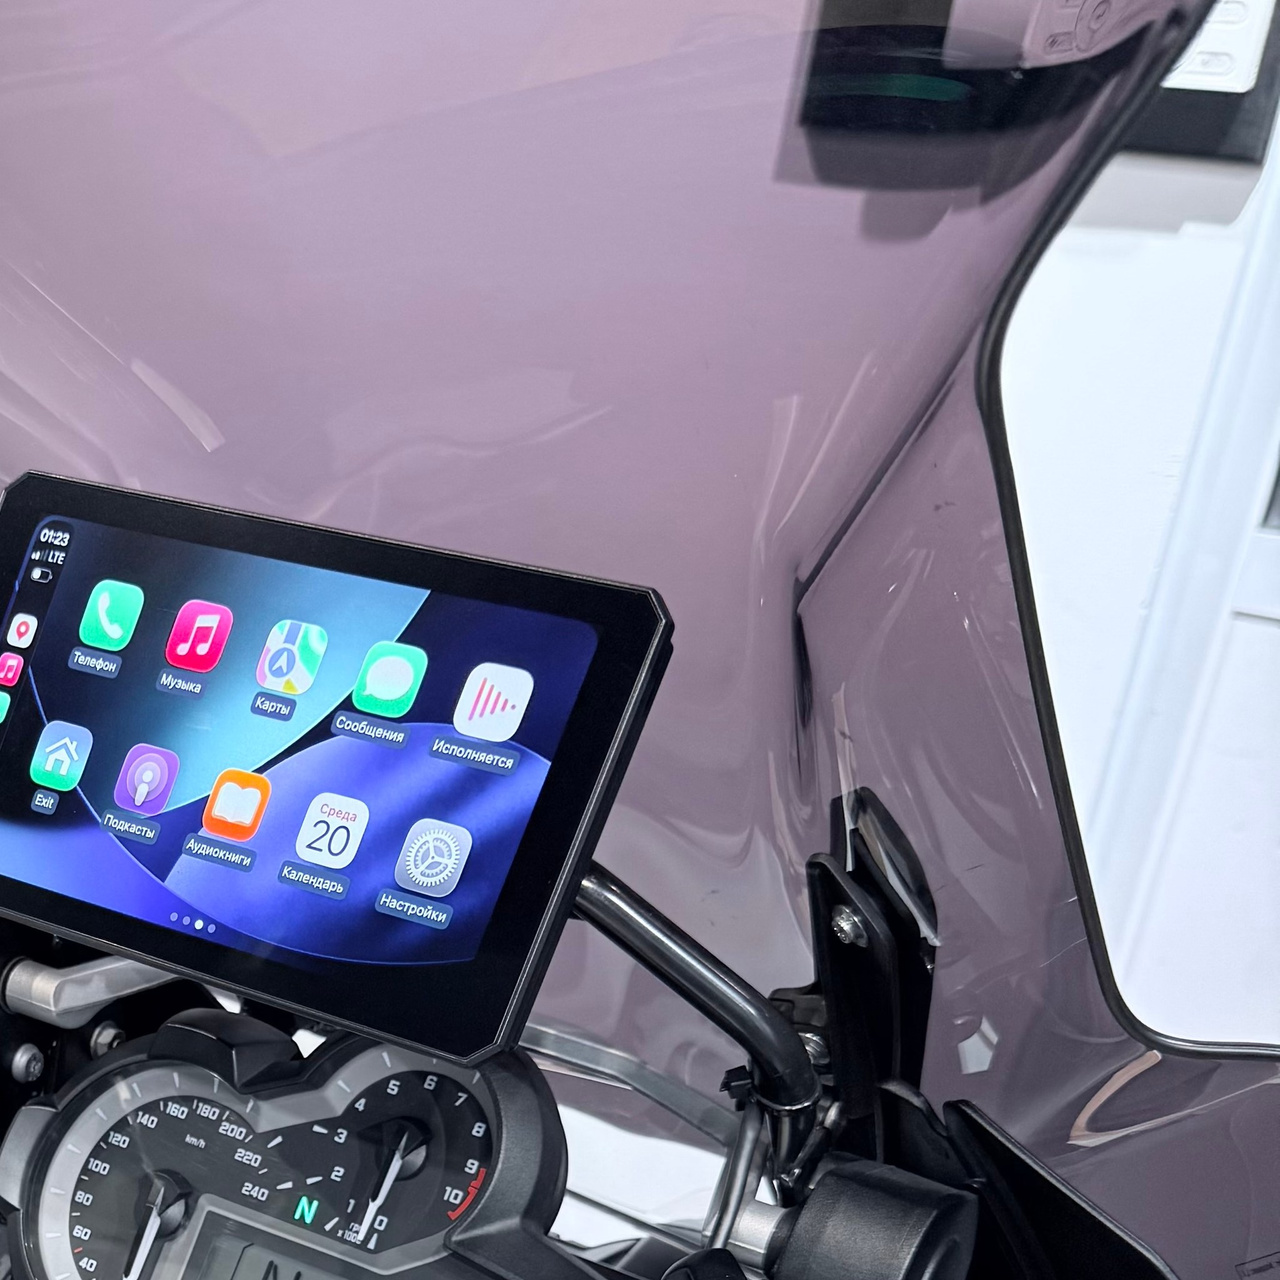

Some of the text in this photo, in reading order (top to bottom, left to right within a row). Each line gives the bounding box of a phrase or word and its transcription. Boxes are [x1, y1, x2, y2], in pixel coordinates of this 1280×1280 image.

[39, 527, 70, 547] 01:23
[47, 550, 66, 566] LTE
[73, 651, 117, 673] Телефон
[160, 673, 202, 694] Музыка
[254, 696, 291, 716] Карты
[335, 716, 405, 744] Сообщения
[432, 738, 514, 770] Исполняется
[34, 793, 54, 809] Exit
[320, 803, 358, 822] Среда
[103, 814, 156, 839] Подкасты
[305, 819, 351, 856] 20
[185, 838, 252, 867] Аудиокниги
[282, 865, 344, 894] Календарь
[379, 893, 447, 923] Настройки
[386, 1079, 401, 1095] 5
[423, 1075, 438, 1091] 6
[354, 1097, 366, 1112] 4
[454, 1092, 468, 1107] 7
[136, 1111, 159, 1129] 140
[165, 1101, 189, 1120] 160
[196, 1102, 220, 1121] 180
[218, 1121, 247, 1141] 200
[333, 1128, 348, 1144] 3
[471, 1122, 487, 1138] 8
[108, 1131, 130, 1149] 120
[184, 1133, 207, 1149] km/h
[88, 1157, 111, 1176] 100
[234, 1148, 262, 1168] 220
[464, 1158, 479, 1174] 9
[330, 1166, 345, 1182] 2
[74, 1190, 94, 1206] 80
[241, 1182, 269, 1202] 240
[443, 1186, 464, 1205] 10
[293, 1195, 319, 1224] N
[346, 1198, 356, 1213] 1
[72, 1225, 91, 1240] 60
[373, 1215, 388, 1231] 0
[78, 1257, 97, 1272] 40
